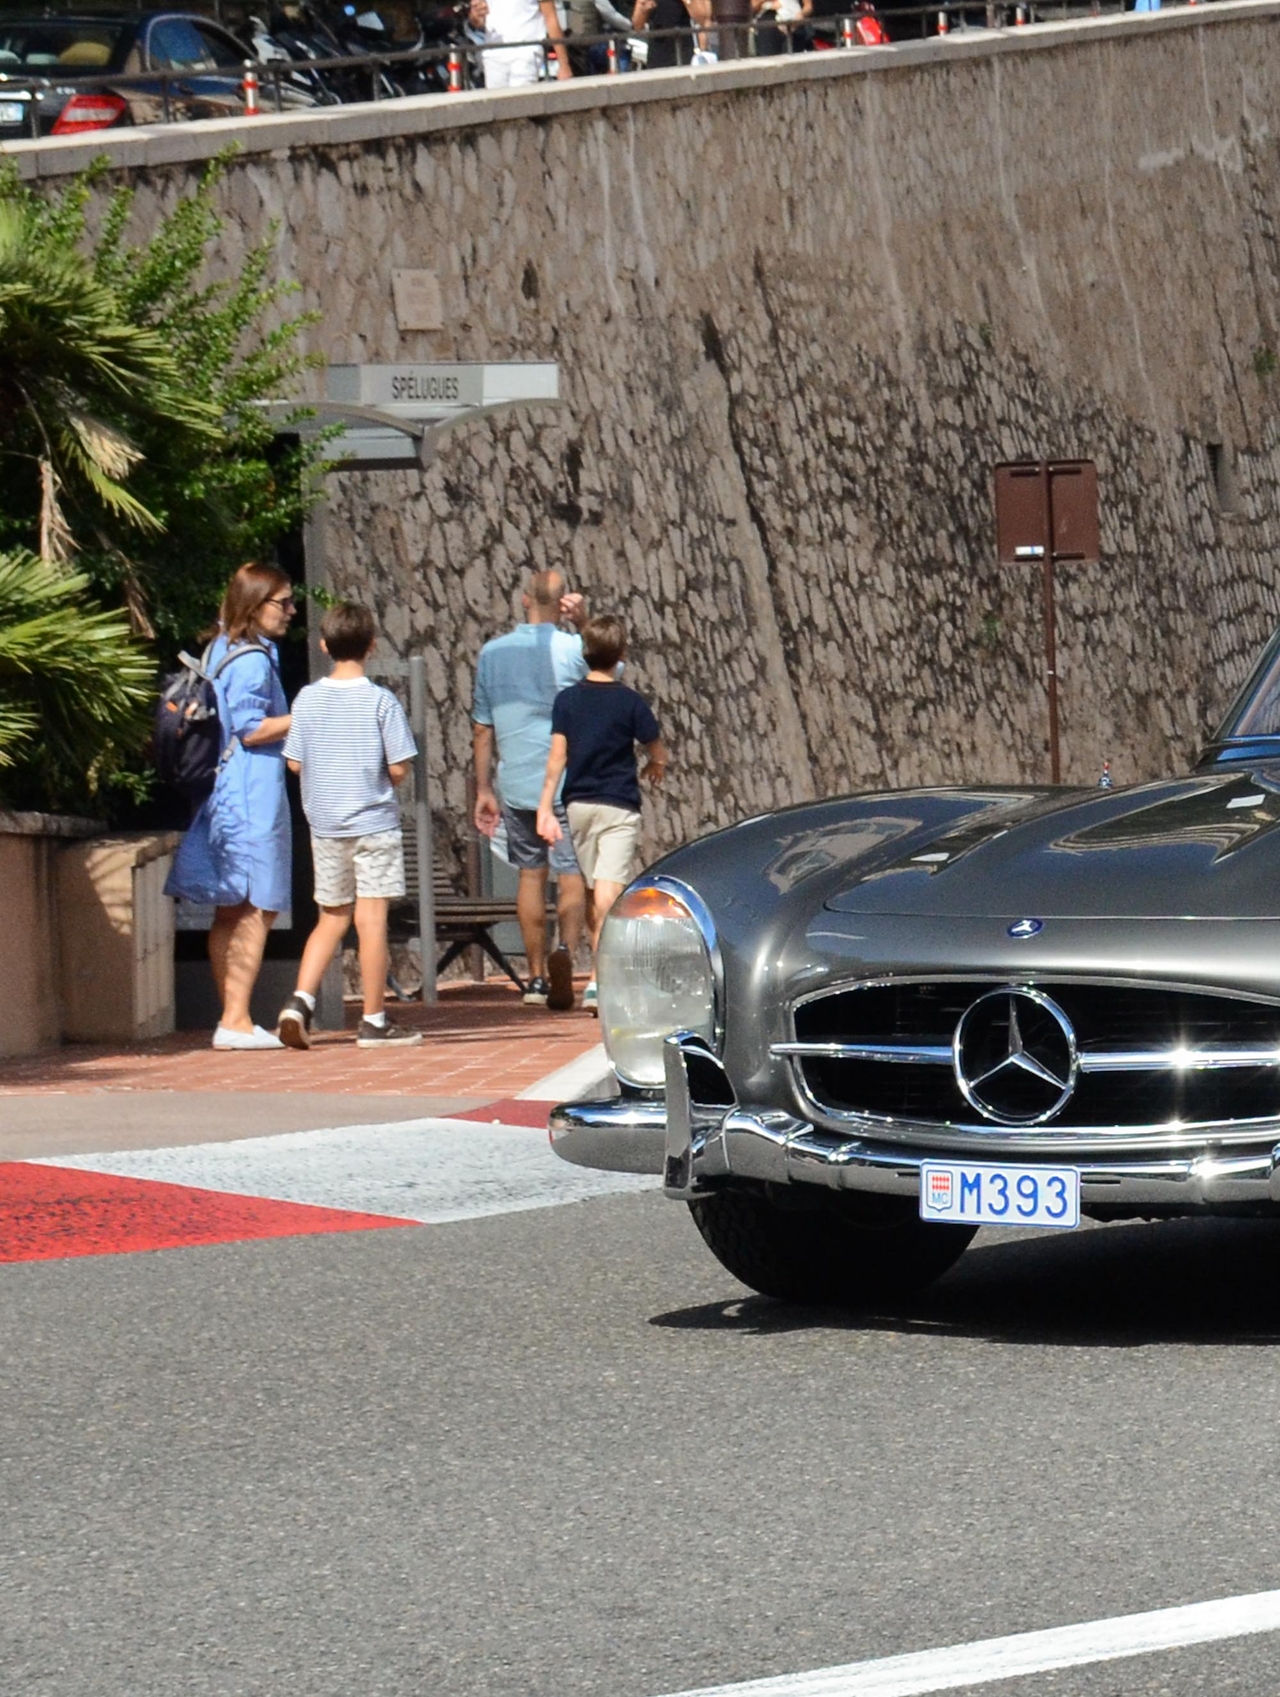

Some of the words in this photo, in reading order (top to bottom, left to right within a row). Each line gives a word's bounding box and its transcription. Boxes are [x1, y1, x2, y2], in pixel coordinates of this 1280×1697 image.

[392, 370, 459, 400] SPÉLUGUES
[931, 1192, 948, 1205] MC
[959, 1171, 1068, 1218] M393
